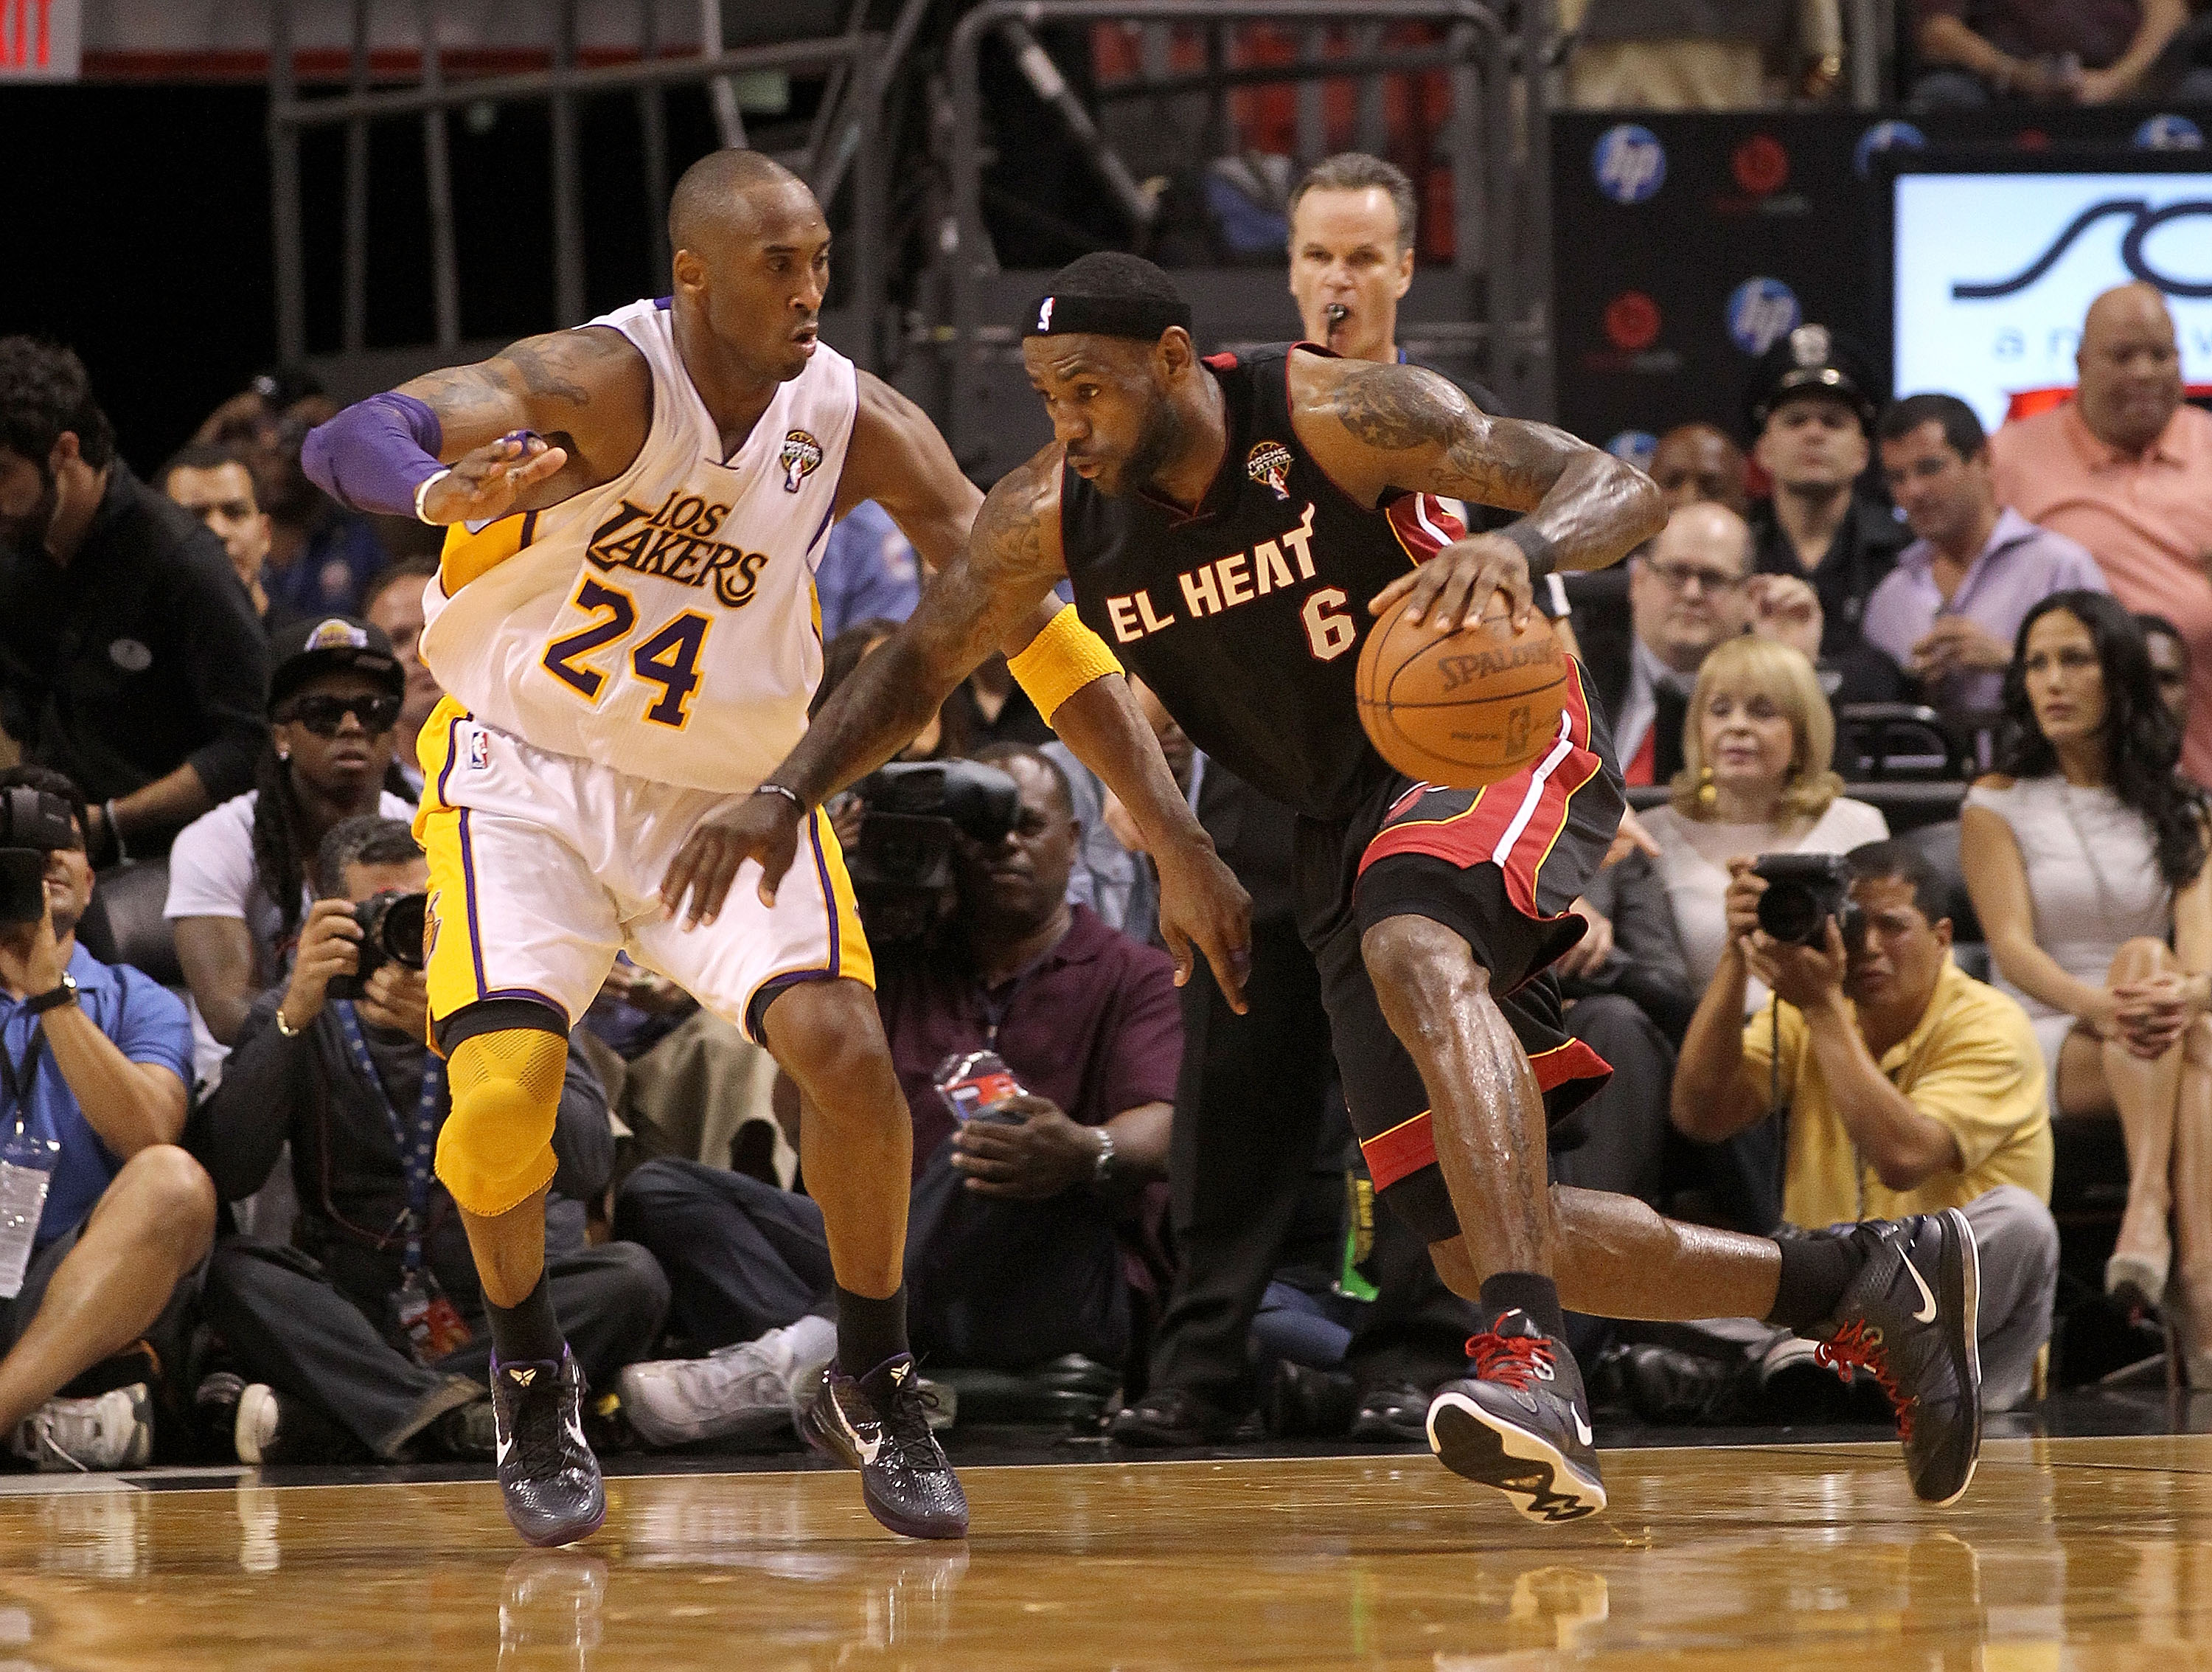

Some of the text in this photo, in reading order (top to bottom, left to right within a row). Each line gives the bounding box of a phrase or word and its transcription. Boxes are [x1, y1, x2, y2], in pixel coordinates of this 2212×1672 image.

[585, 499, 769, 608] LAKERS
[647, 490, 731, 537] LOS
[1106, 502, 1317, 643] EL HEAT
[539, 571, 715, 732] 24
[1300, 585, 1357, 662] 6
[1438, 636, 1562, 692] SPALD
